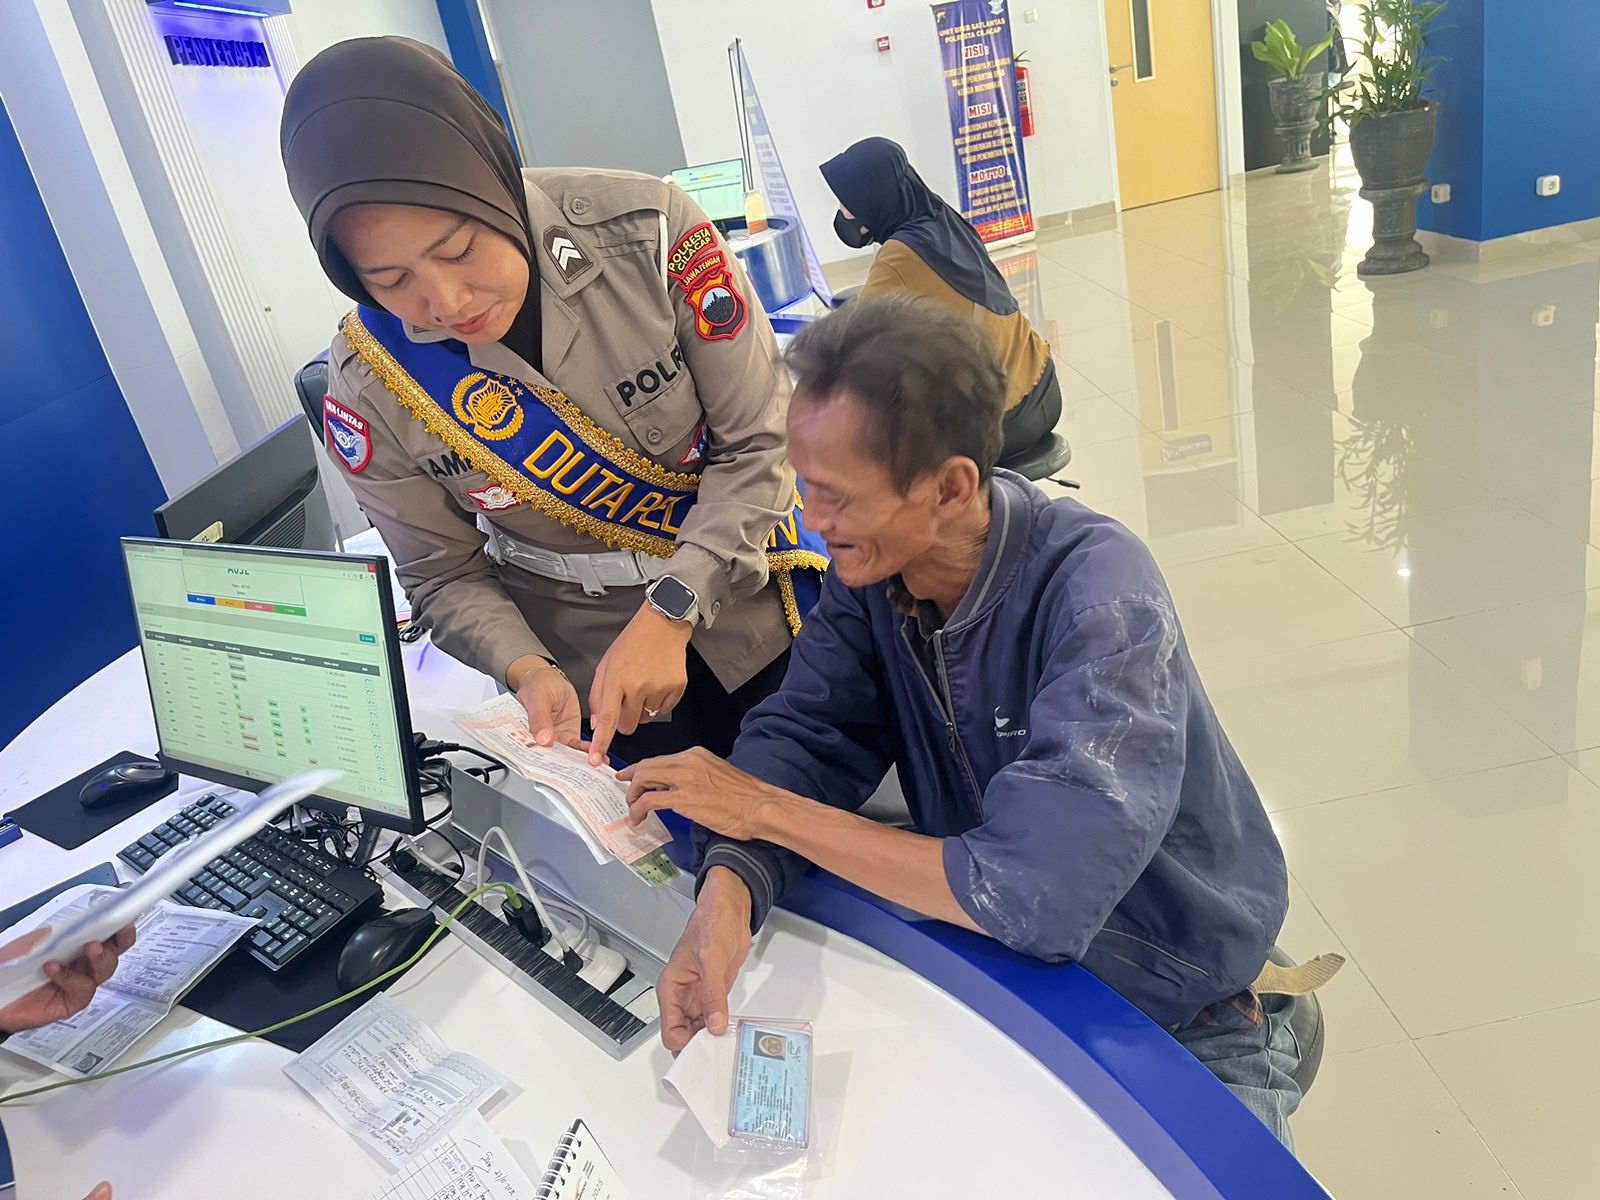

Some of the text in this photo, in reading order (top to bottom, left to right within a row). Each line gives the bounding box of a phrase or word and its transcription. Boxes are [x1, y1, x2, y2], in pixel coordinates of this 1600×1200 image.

[963, 44, 983, 58] VISI
[968, 103, 991, 119] MISI
[970, 166, 1005, 184] MOTTO
[668, 228, 711, 272] POLRESTA
[678, 236, 711, 271] CILACAP
[683, 255, 721, 286] JAWA TENGAH
[523, 429, 635, 520] DUTA
